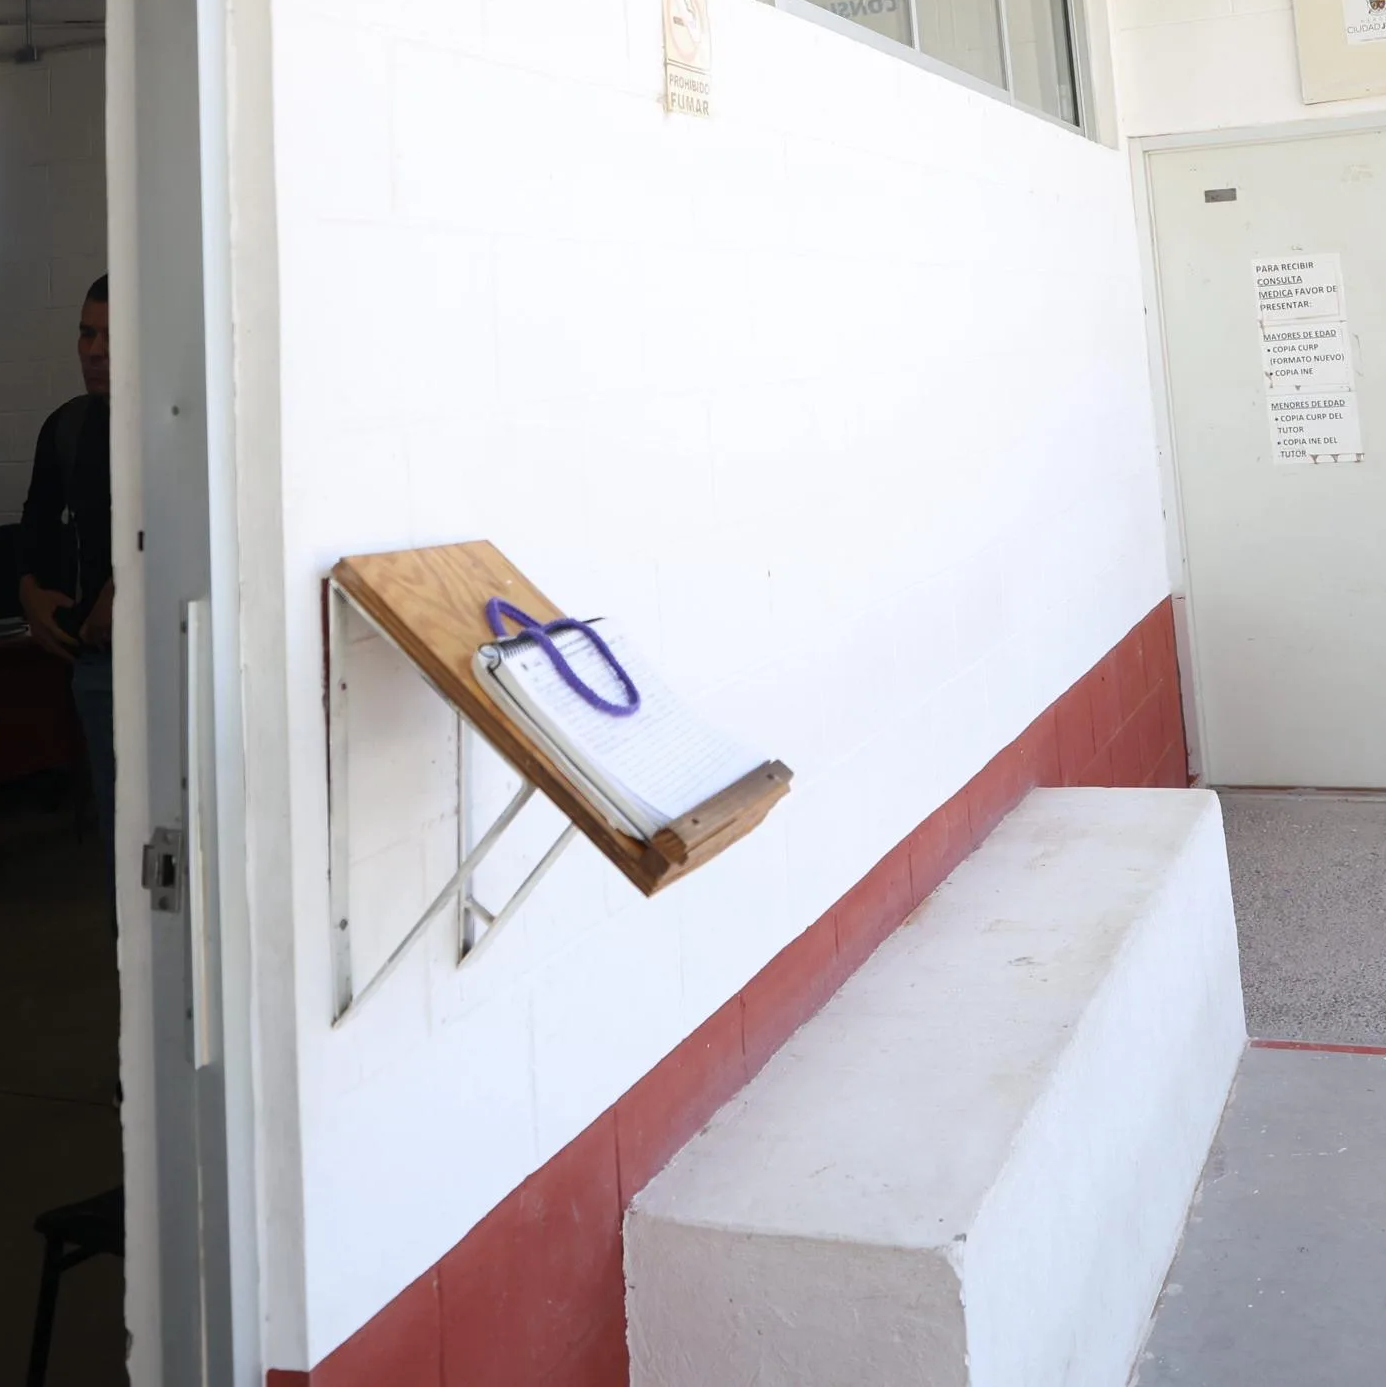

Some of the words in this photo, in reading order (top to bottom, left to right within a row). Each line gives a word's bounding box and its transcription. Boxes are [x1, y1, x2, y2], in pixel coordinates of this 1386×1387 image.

[1347, 23, 1381, 35] CIUDAD
[669, 73, 710, 96] PROHIBIDO
[670, 92, 710, 116] FUMAR
[1256, 264, 1279, 273] PARA
[1281, 261, 1314, 271] RECIBIR
[1257, 275, 1303, 287] CONSULTA
[1258, 289, 1293, 300] MEDICA
[1294, 286, 1324, 296] FAVOR
[1326, 285, 1338, 293] DE
[1263, 332, 1301, 342] MAYORES
[1303, 331, 1313, 339] DE
[1315, 329, 1337, 338] EDAD
[1273, 345, 1296, 353] COPIA
[1298, 343, 1319, 351] CURP
[1270, 355, 1312, 365] (FORMATO
[1313, 353, 1345, 362] NUEVO)
[1275, 369, 1299, 377] COPIA
[1271, 401, 1309, 411] MENORES
[1311, 400, 1322, 408] DE
[1323, 399, 1346, 408] EDAD
[1280, 414, 1305, 422] COPIA
[1306, 413, 1327, 421] CURP
[1277, 426, 1304, 434] TUTOR
[1283, 438, 1307, 446] COPIA
[1308, 437, 1322, 445] INE
[1323, 436, 1338, 444] DEL
[1280, 450, 1307, 458] TUTOR
